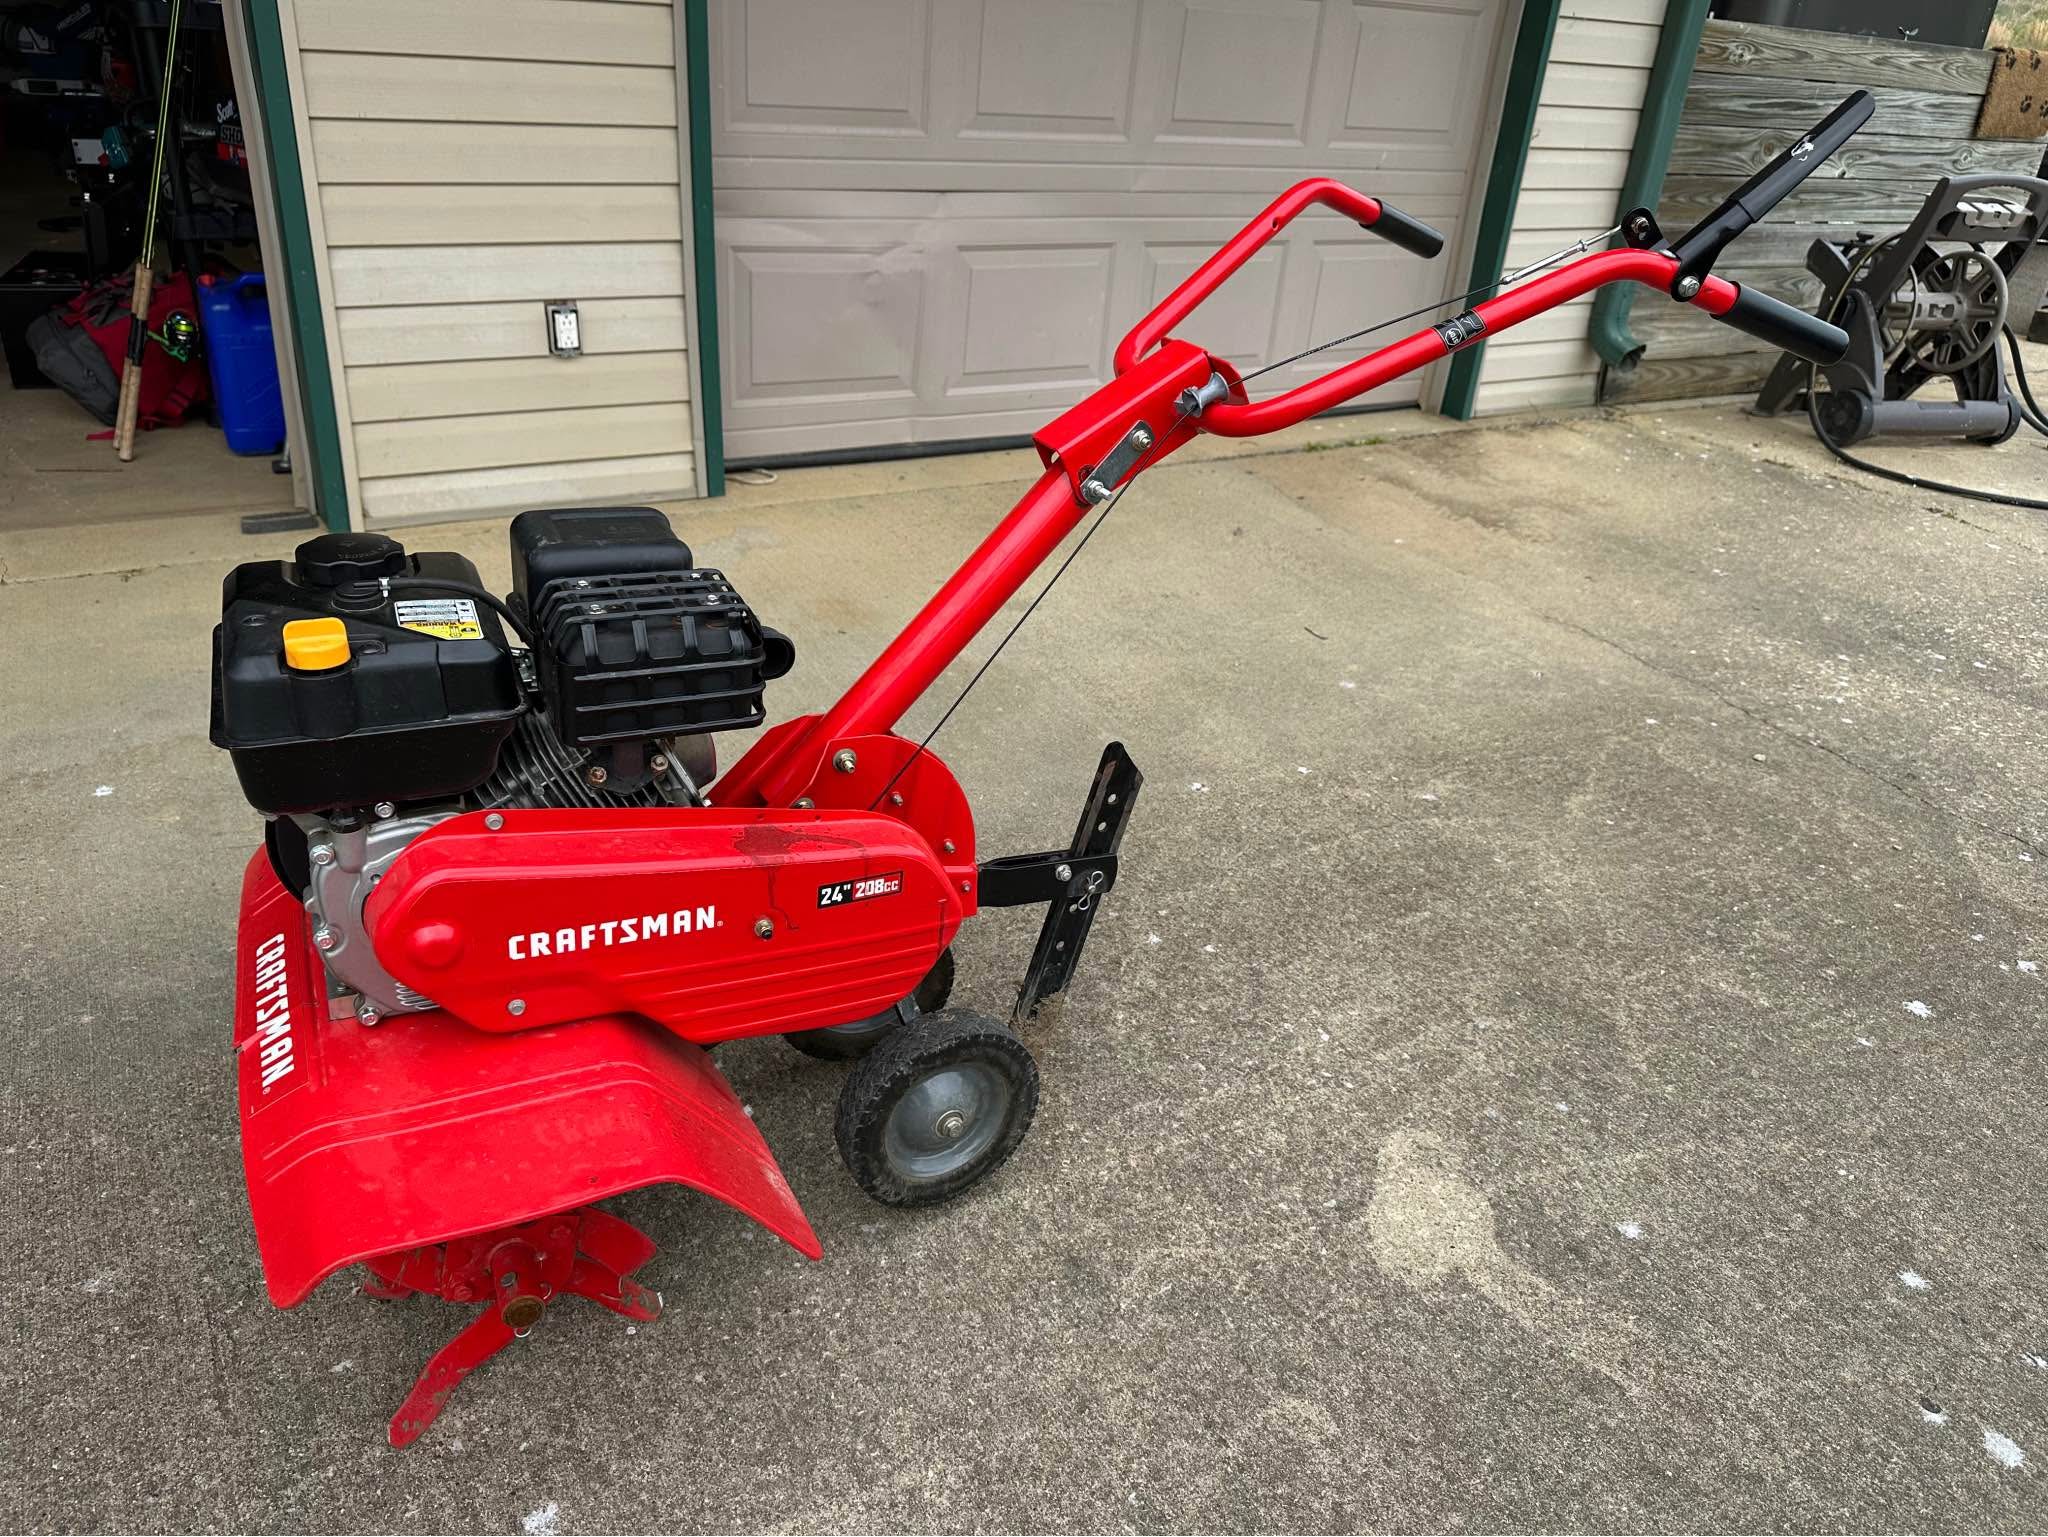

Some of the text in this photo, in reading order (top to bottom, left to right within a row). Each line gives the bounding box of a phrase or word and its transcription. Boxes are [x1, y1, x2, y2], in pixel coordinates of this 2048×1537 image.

[223, 128, 243, 143] SHO
[1449, 331, 1459, 344] STOP
[820, 883, 851, 905] 24"
[508, 905, 715, 960] CRAFTSMAN
[256, 933, 295, 1088] CRAFTSMAN
